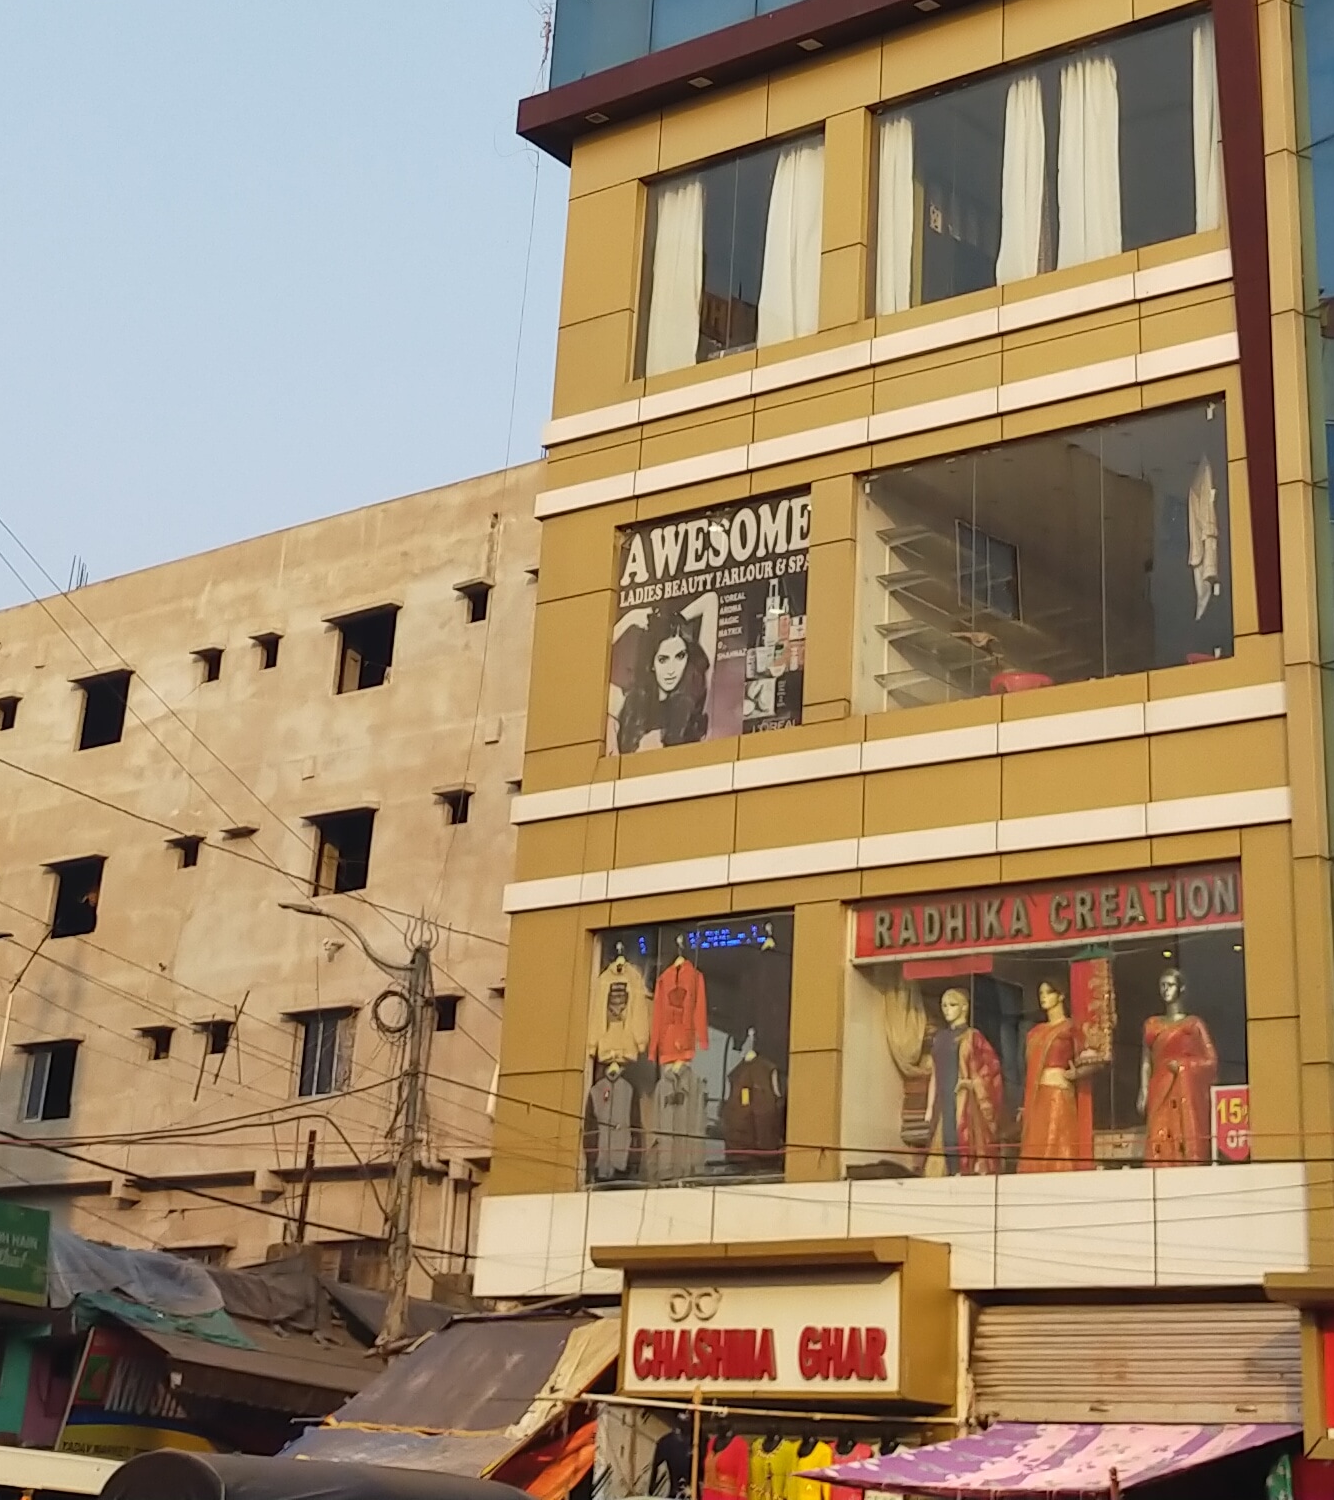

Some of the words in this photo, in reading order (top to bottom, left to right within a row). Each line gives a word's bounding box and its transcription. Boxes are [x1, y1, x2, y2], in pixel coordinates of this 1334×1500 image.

[620, 495, 811, 586] AWESOME
[620, 582, 663, 607] LADIES
[664, 572, 714, 599] BEAUTY
[716, 561, 772, 588] PARLOUR
[776, 559, 787, 576] &
[872, 896, 1033, 949] RADHIKA
[1049, 873, 1239, 934] CREATION
[633, 1328, 778, 1381] CHASHMA
[798, 1327, 888, 1382] GHAR
